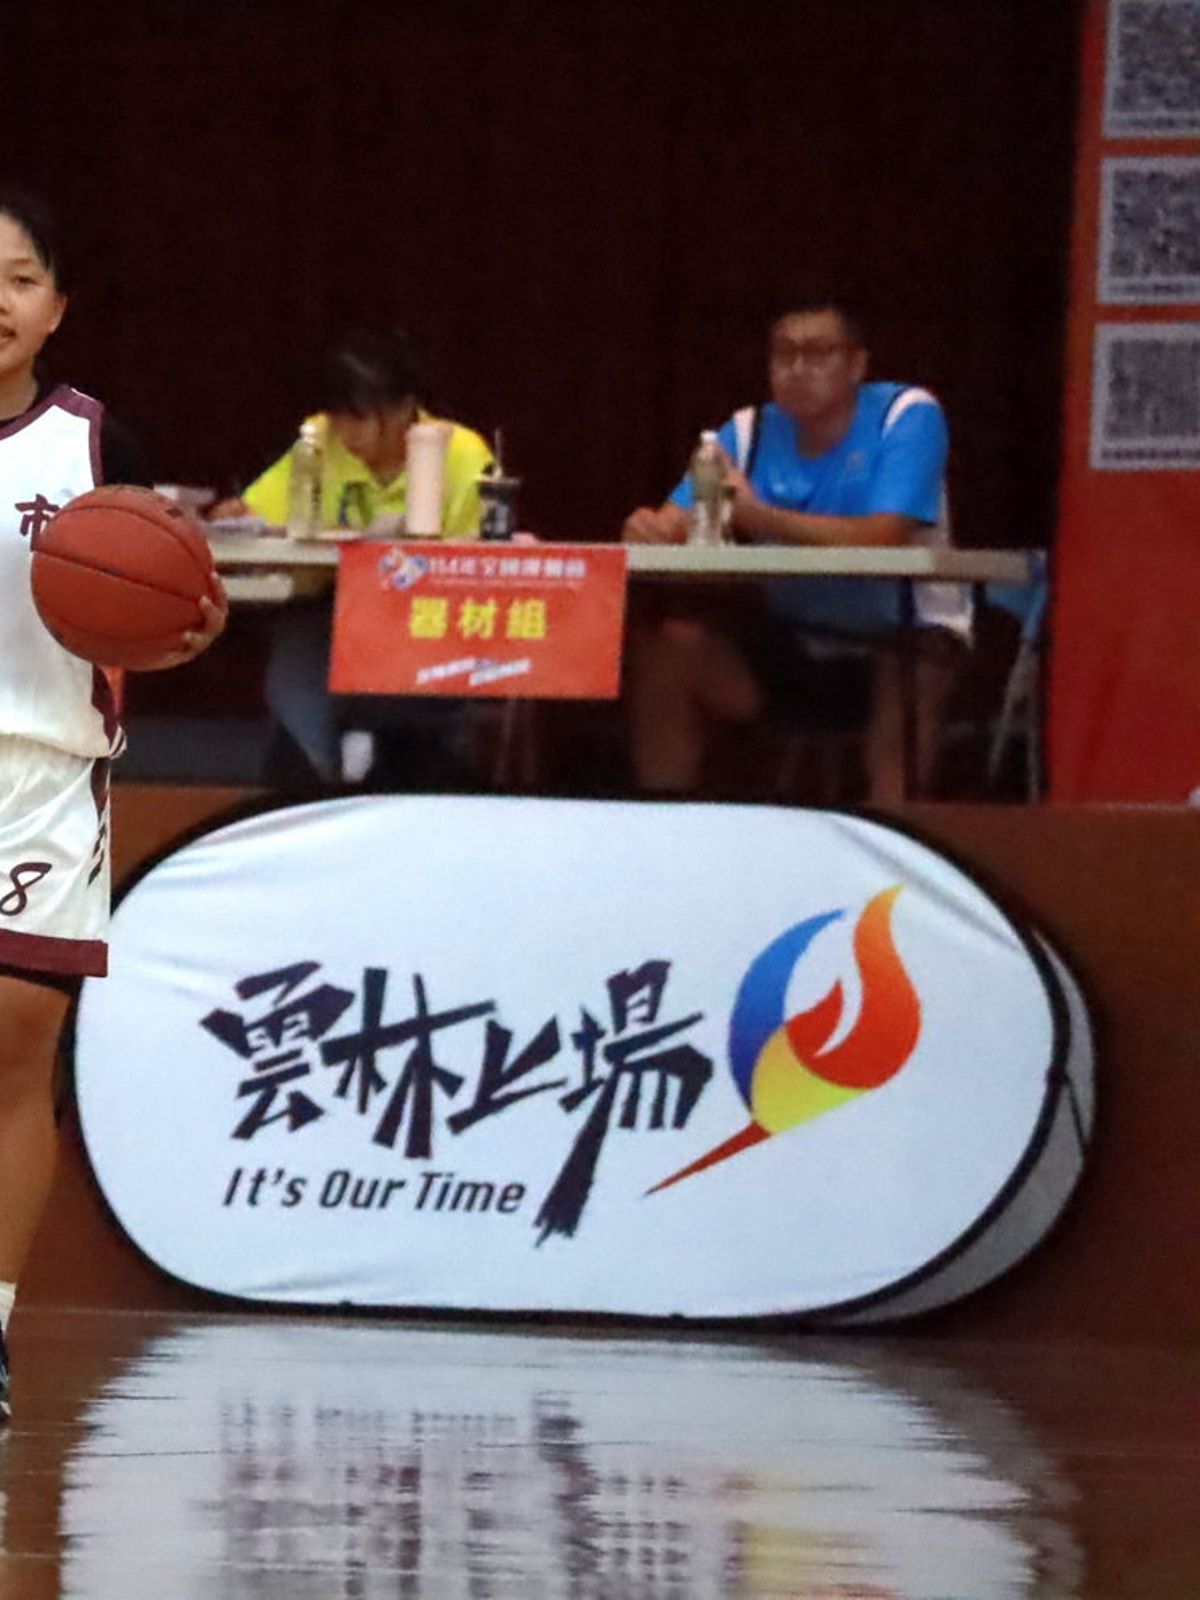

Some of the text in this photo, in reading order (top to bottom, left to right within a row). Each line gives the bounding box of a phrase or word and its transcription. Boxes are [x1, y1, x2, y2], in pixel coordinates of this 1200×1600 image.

[408, 596, 546, 640] 器材組
[200, 960, 713, 1247] 雲林上場
[223, 1167, 526, 1214] It's Our Time
